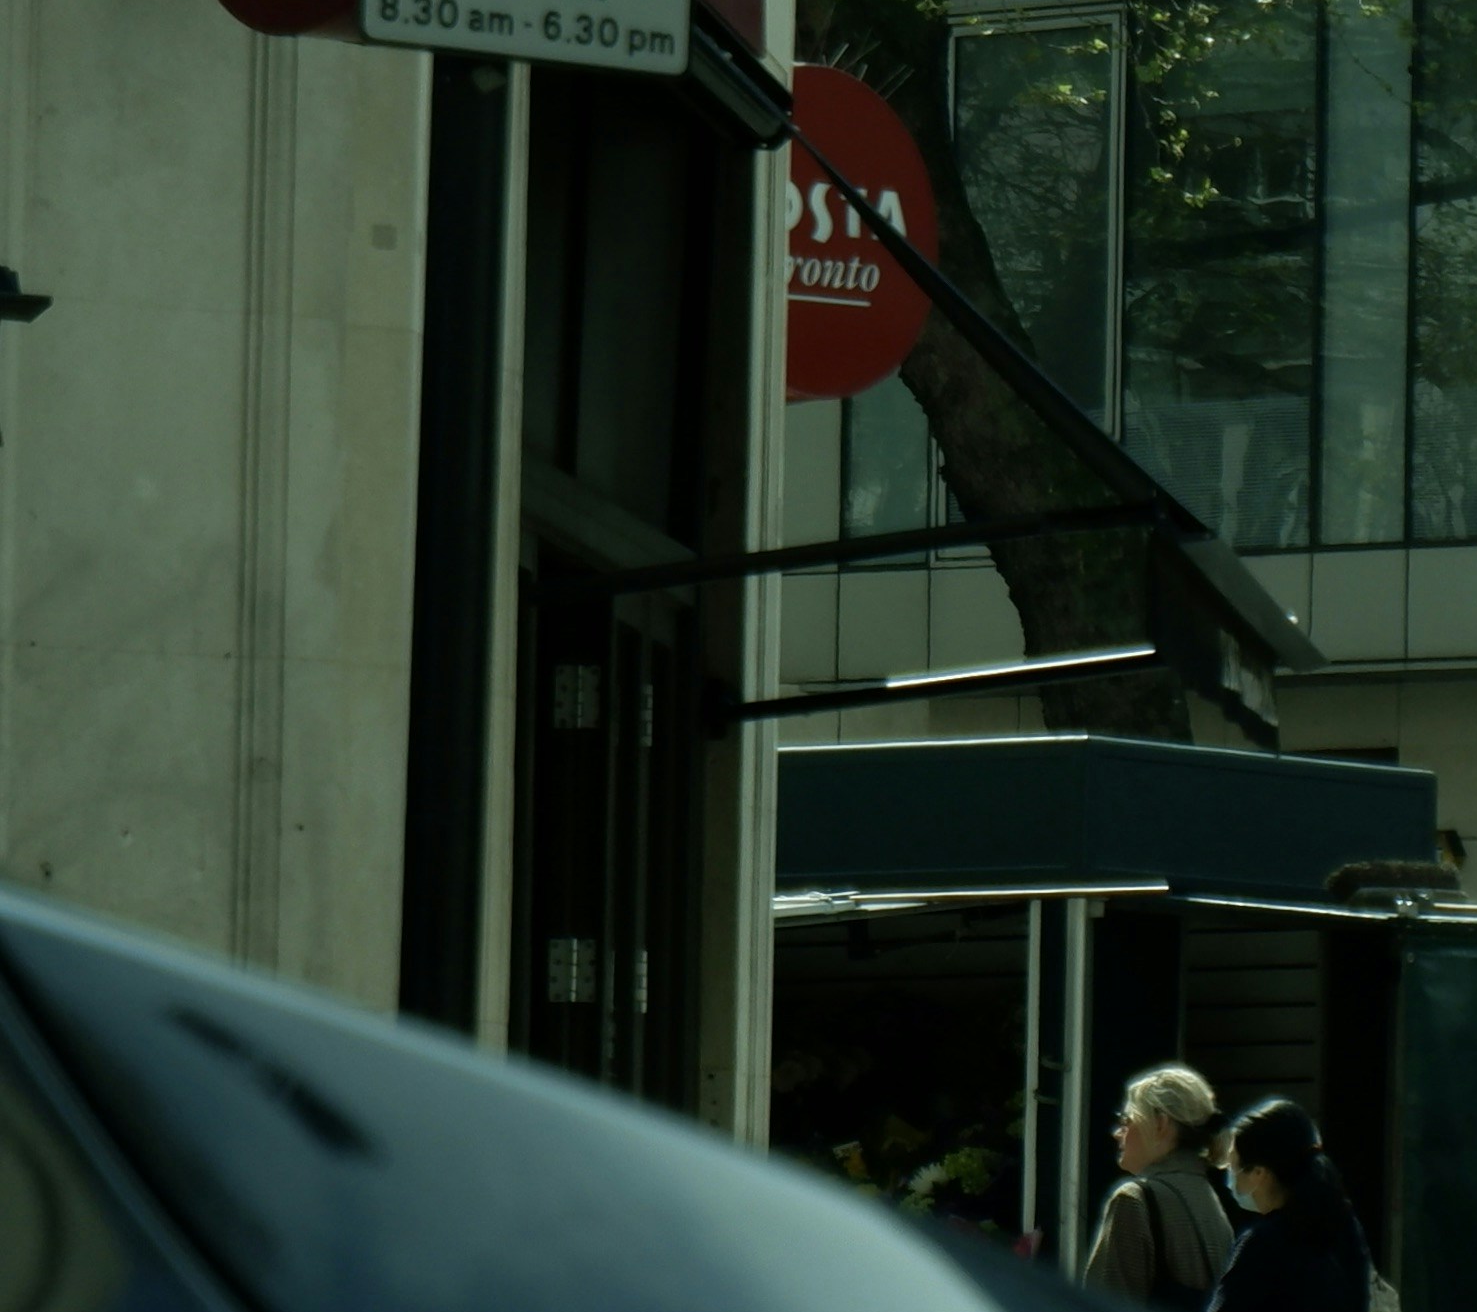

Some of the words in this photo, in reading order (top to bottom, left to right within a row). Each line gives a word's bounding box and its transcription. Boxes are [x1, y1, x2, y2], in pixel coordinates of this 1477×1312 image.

[468, 5, 515, 36] am
[543, 10, 619, 49] 6.30
[628, 26, 676, 57] pm
[785, 180, 908, 244] OSTA
